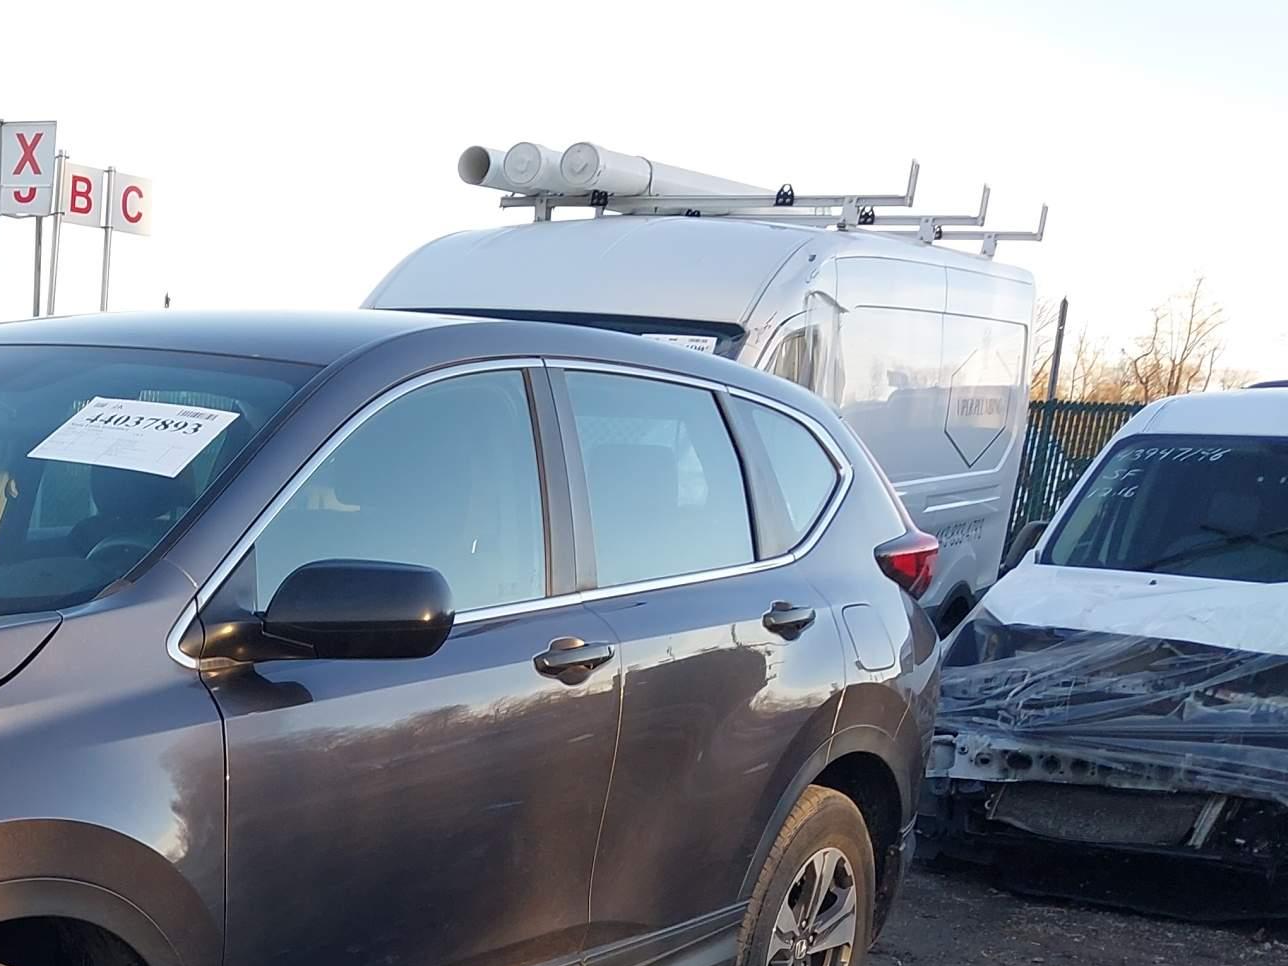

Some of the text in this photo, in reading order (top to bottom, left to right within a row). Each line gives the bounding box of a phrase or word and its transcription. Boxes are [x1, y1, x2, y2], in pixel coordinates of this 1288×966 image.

[12, 132, 44, 176] X
[70, 175, 93, 215] B
[121, 185, 143, 224] C
[86, 412, 203, 434] 44037893
